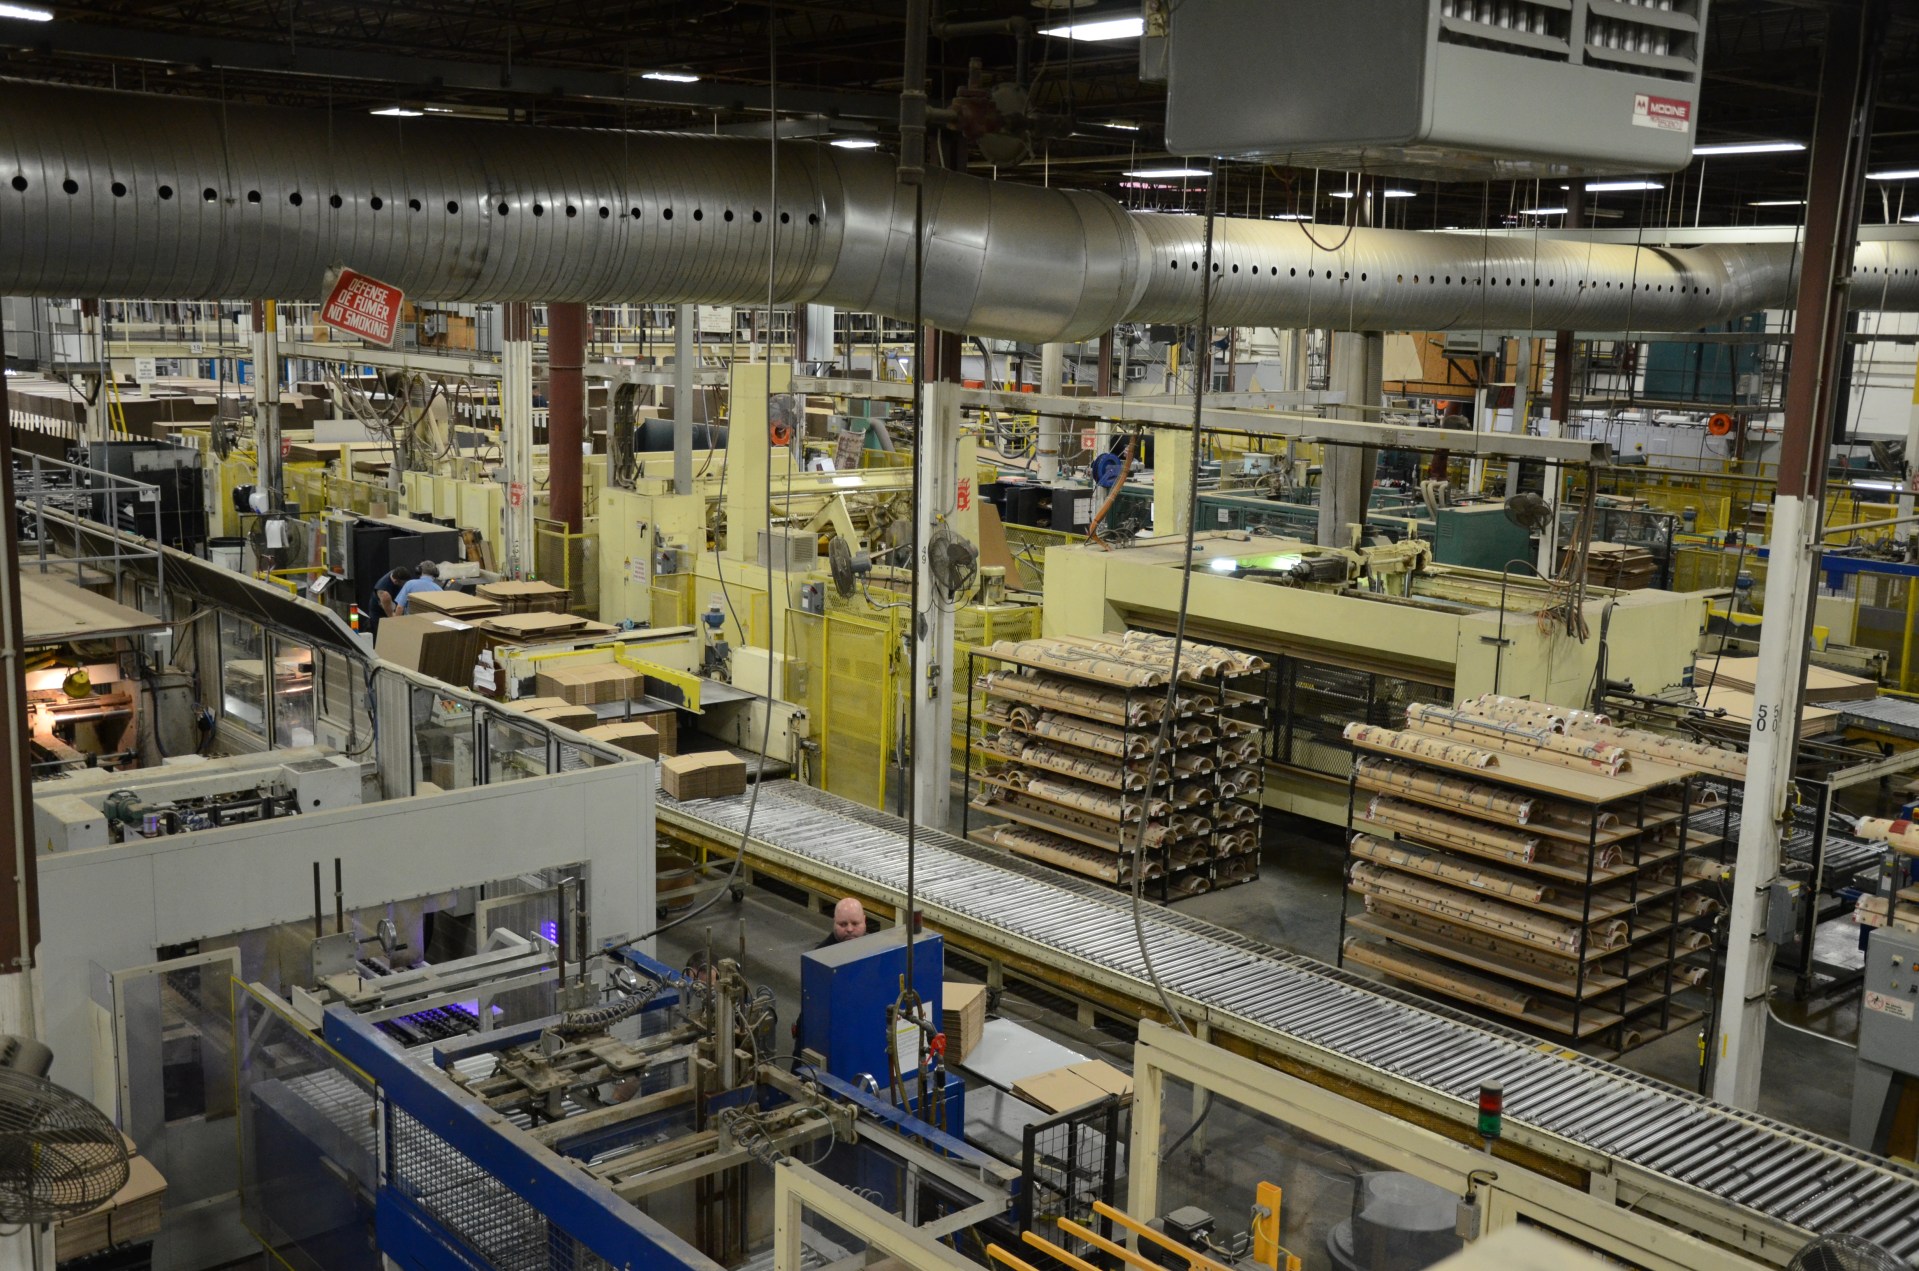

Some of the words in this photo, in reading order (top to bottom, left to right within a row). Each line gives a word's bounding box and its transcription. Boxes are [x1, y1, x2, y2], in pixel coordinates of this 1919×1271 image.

[337, 289, 354, 306] DE
[353, 295, 390, 321] FUMER
[327, 304, 344, 322] NO
[343, 310, 389, 339] SMOKING
[1757, 704, 1768, 731] 50
